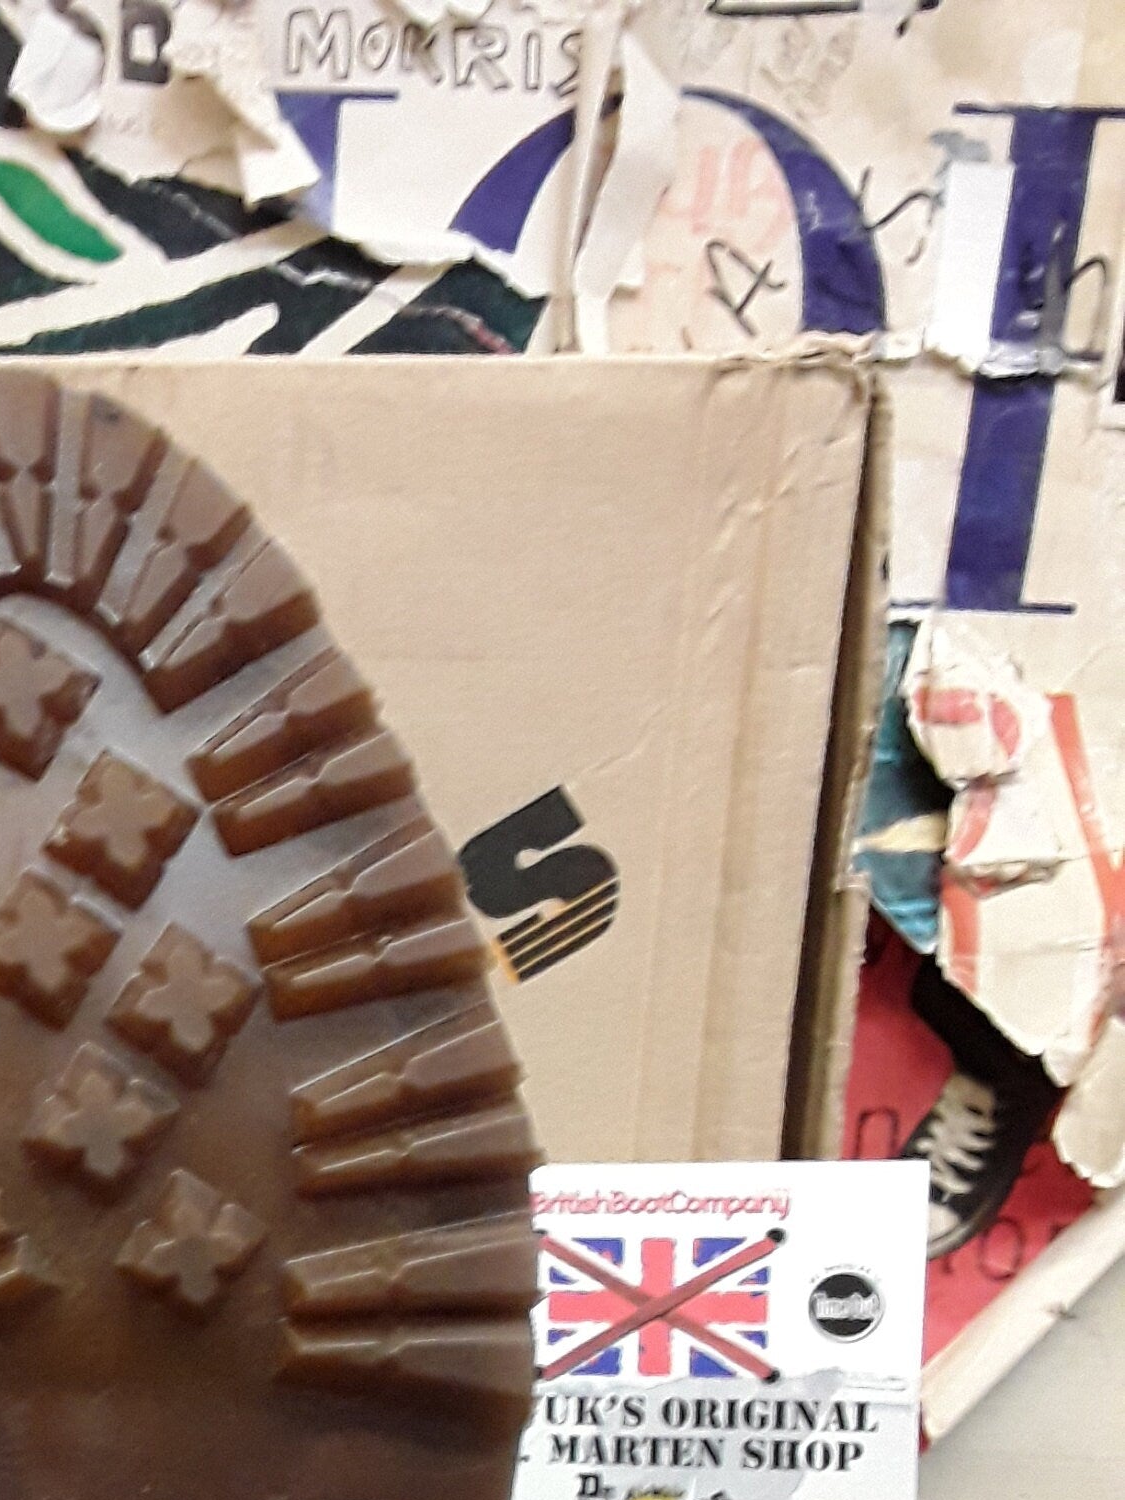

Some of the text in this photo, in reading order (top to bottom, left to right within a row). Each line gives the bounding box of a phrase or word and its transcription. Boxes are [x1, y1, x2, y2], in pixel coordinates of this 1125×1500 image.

[543, 1395, 879, 1433] UK'S ORIGINAL
[548, 1433, 864, 1472] MARTEN SHOP
